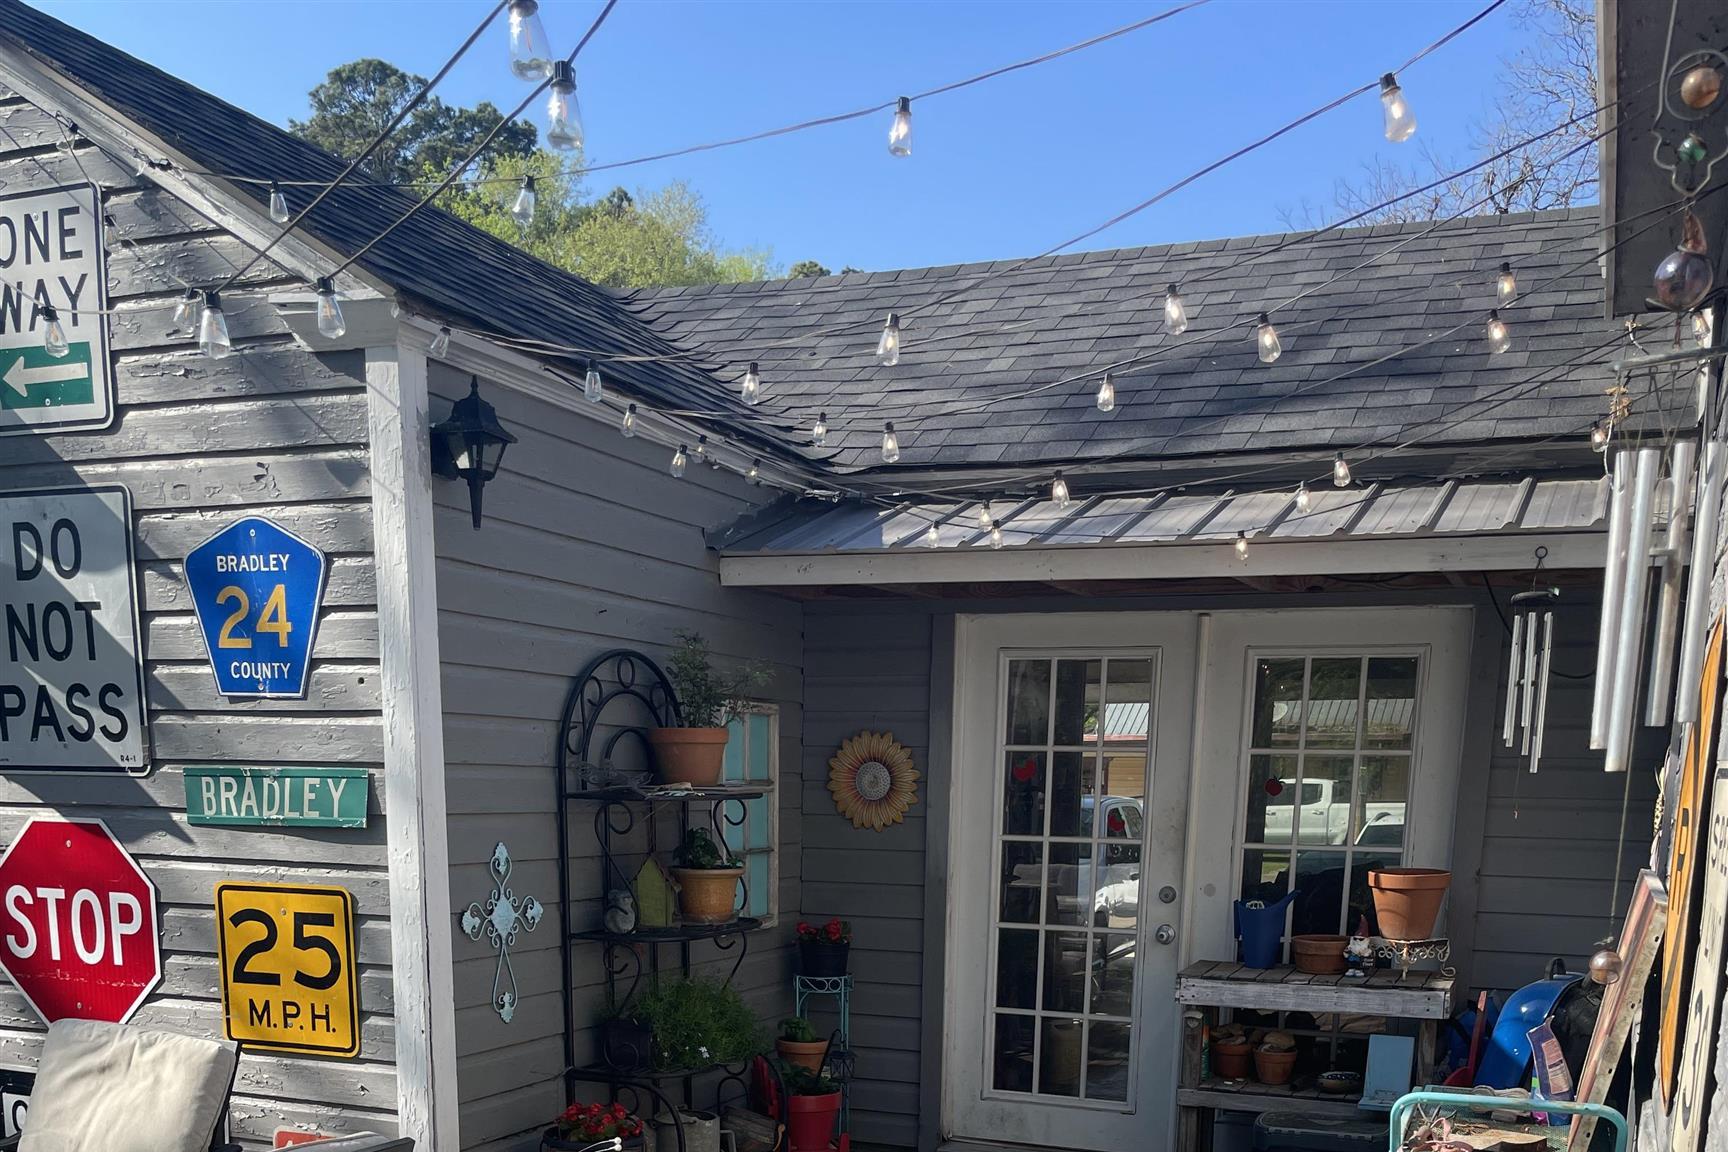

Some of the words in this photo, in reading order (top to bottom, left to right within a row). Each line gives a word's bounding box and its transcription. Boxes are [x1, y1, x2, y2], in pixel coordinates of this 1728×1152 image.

[0, 206, 83, 269] ONE
[0, 273, 88, 335] WAY
[12, 518, 82, 580] DO
[216, 554, 290, 573] BRADLEY
[5, 601, 102, 662] NOT
[216, 584, 292, 649] 24
[230, 661, 291, 683] COUNTY
[0, 683, 129, 743] PASS
[201, 776, 347, 818] BRADLEY
[5, 884, 142, 966] STOP
[229, 908, 342, 990] 25
[249, 998, 337, 1033] M.P.H.
